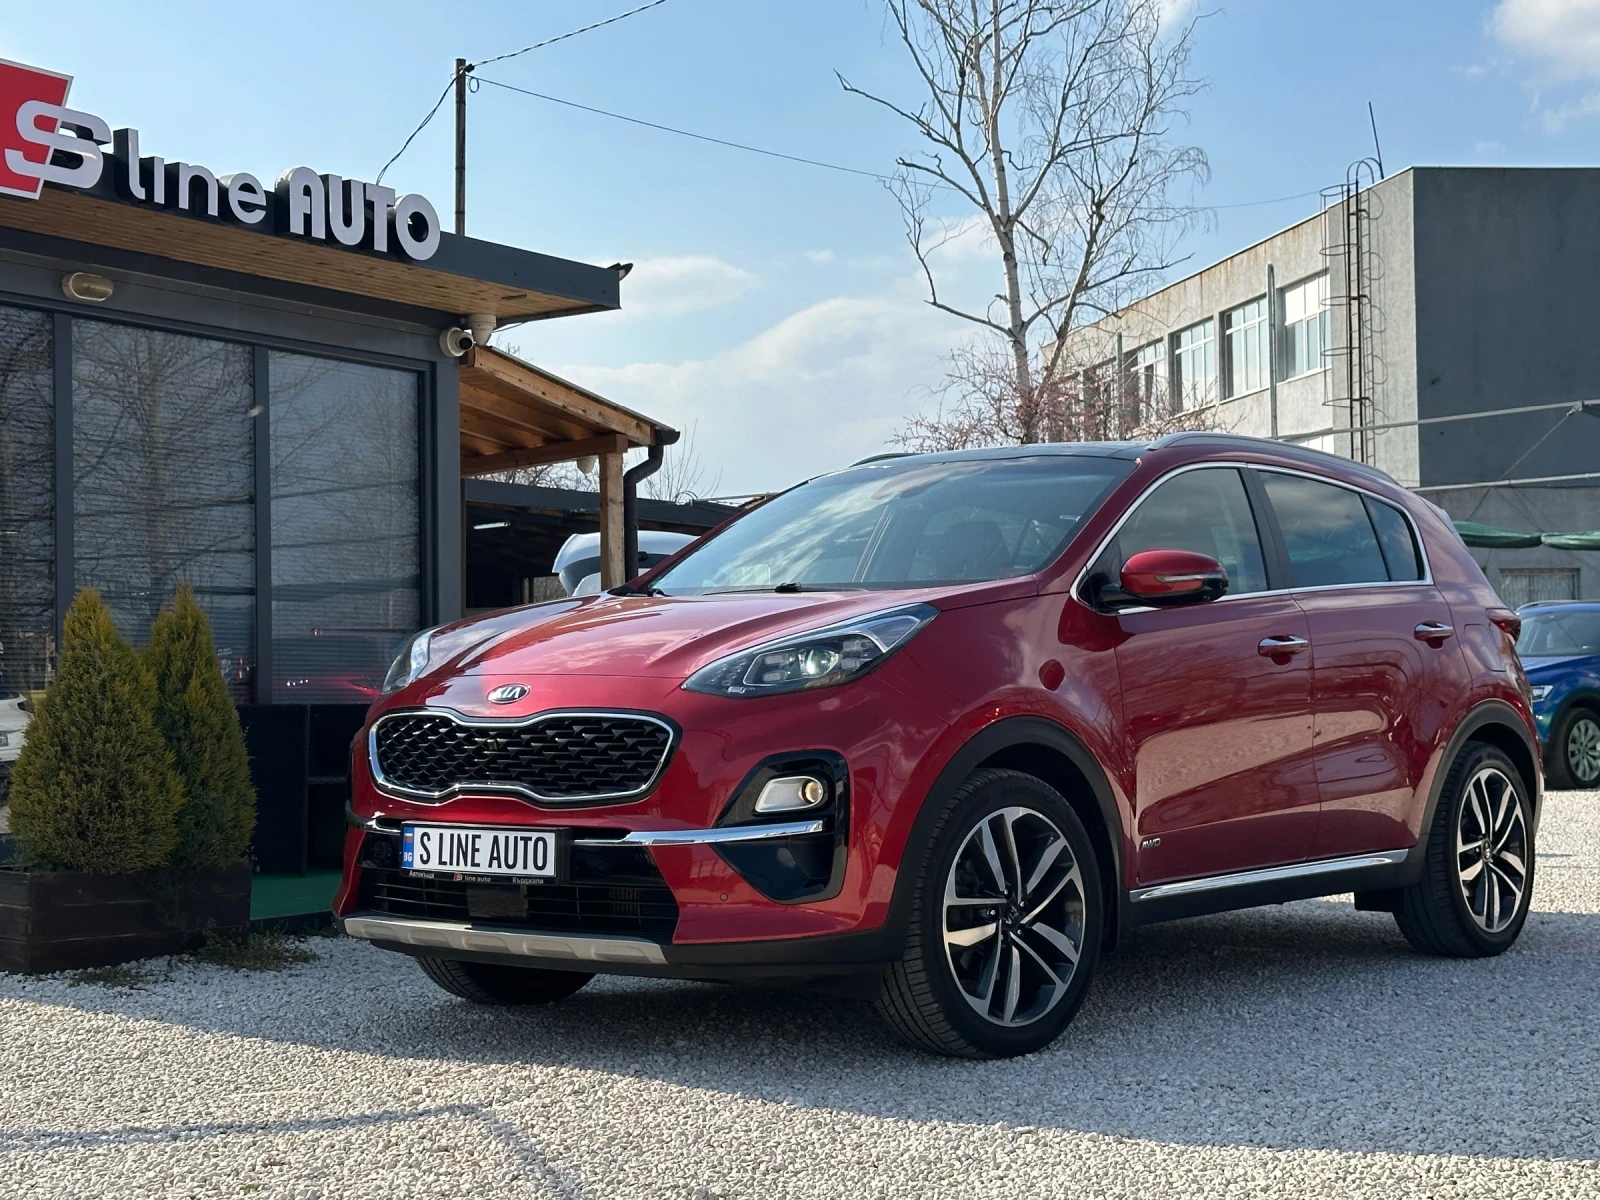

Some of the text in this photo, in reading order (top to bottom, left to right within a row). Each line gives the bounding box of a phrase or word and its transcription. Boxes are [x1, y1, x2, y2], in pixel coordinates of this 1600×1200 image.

[5, 100, 441, 261] S line AUTO
[489, 687, 521, 699] KIA
[1140, 837, 1161, 850] AWD
[403, 851, 413, 862] BG
[419, 831, 548, 871] S LINE AUTO
